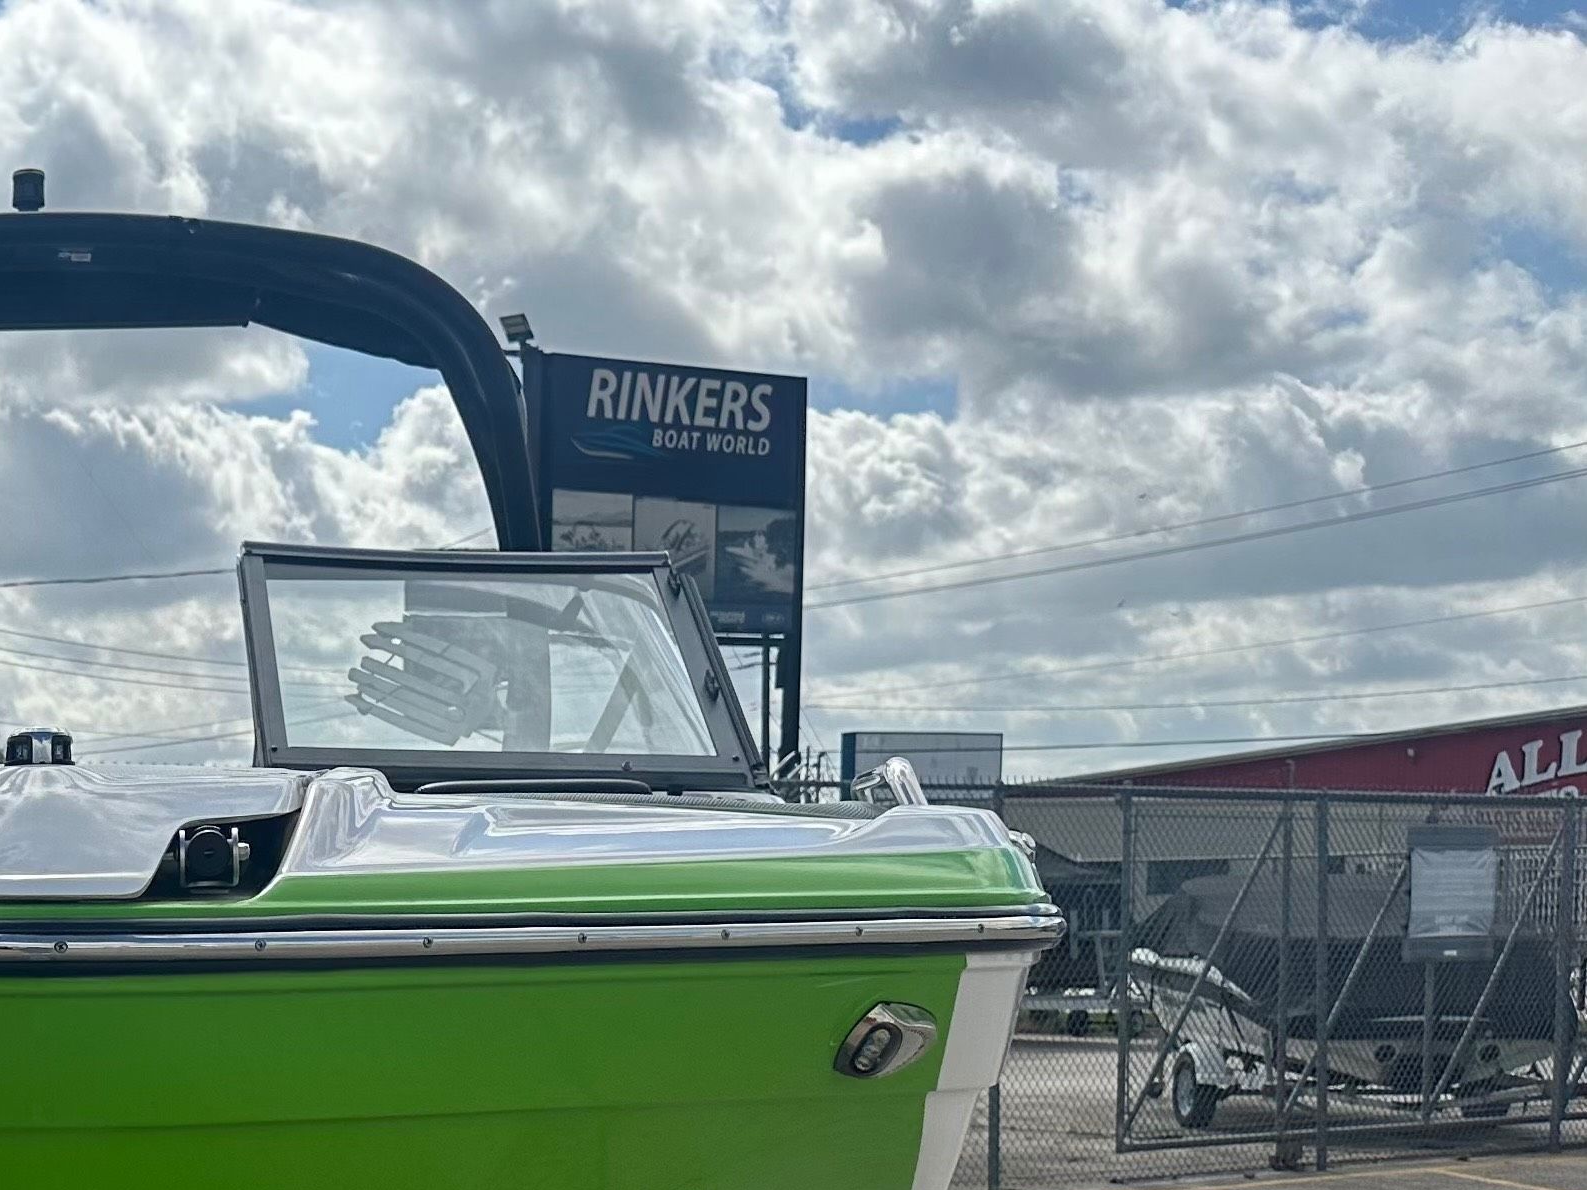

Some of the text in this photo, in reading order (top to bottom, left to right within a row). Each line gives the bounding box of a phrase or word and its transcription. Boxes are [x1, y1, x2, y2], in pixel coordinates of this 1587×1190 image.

[586, 368, 774, 432] RINKERS
[652, 428, 770, 456] BOAT WORLD
[1485, 729, 1587, 797] ALL
